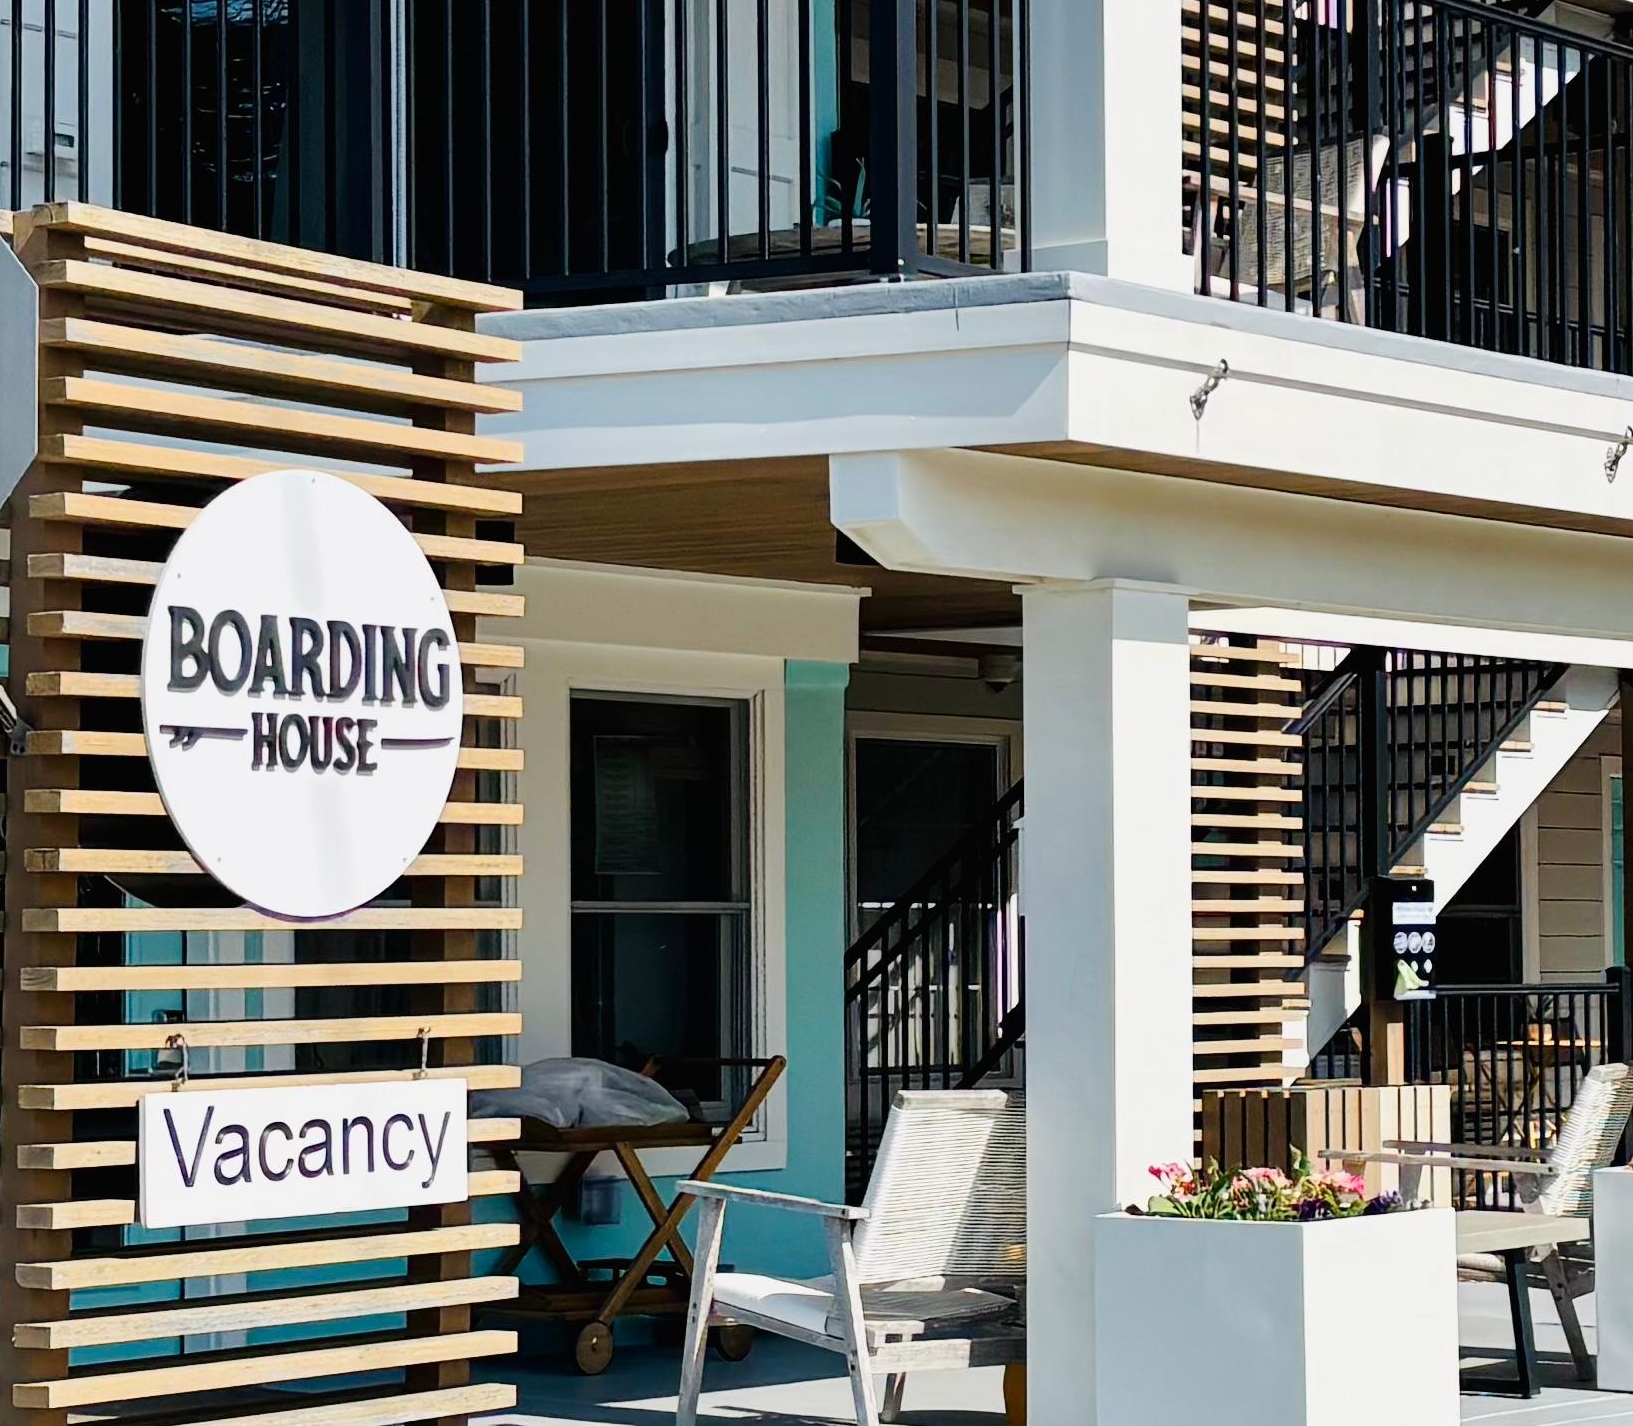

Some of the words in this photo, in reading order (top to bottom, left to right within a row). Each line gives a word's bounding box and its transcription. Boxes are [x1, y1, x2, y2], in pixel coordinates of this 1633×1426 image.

[167, 606, 451, 711] BOARDING
[251, 712, 378, 775] HOUSE
[163, 1105, 451, 1189] Vacancy
